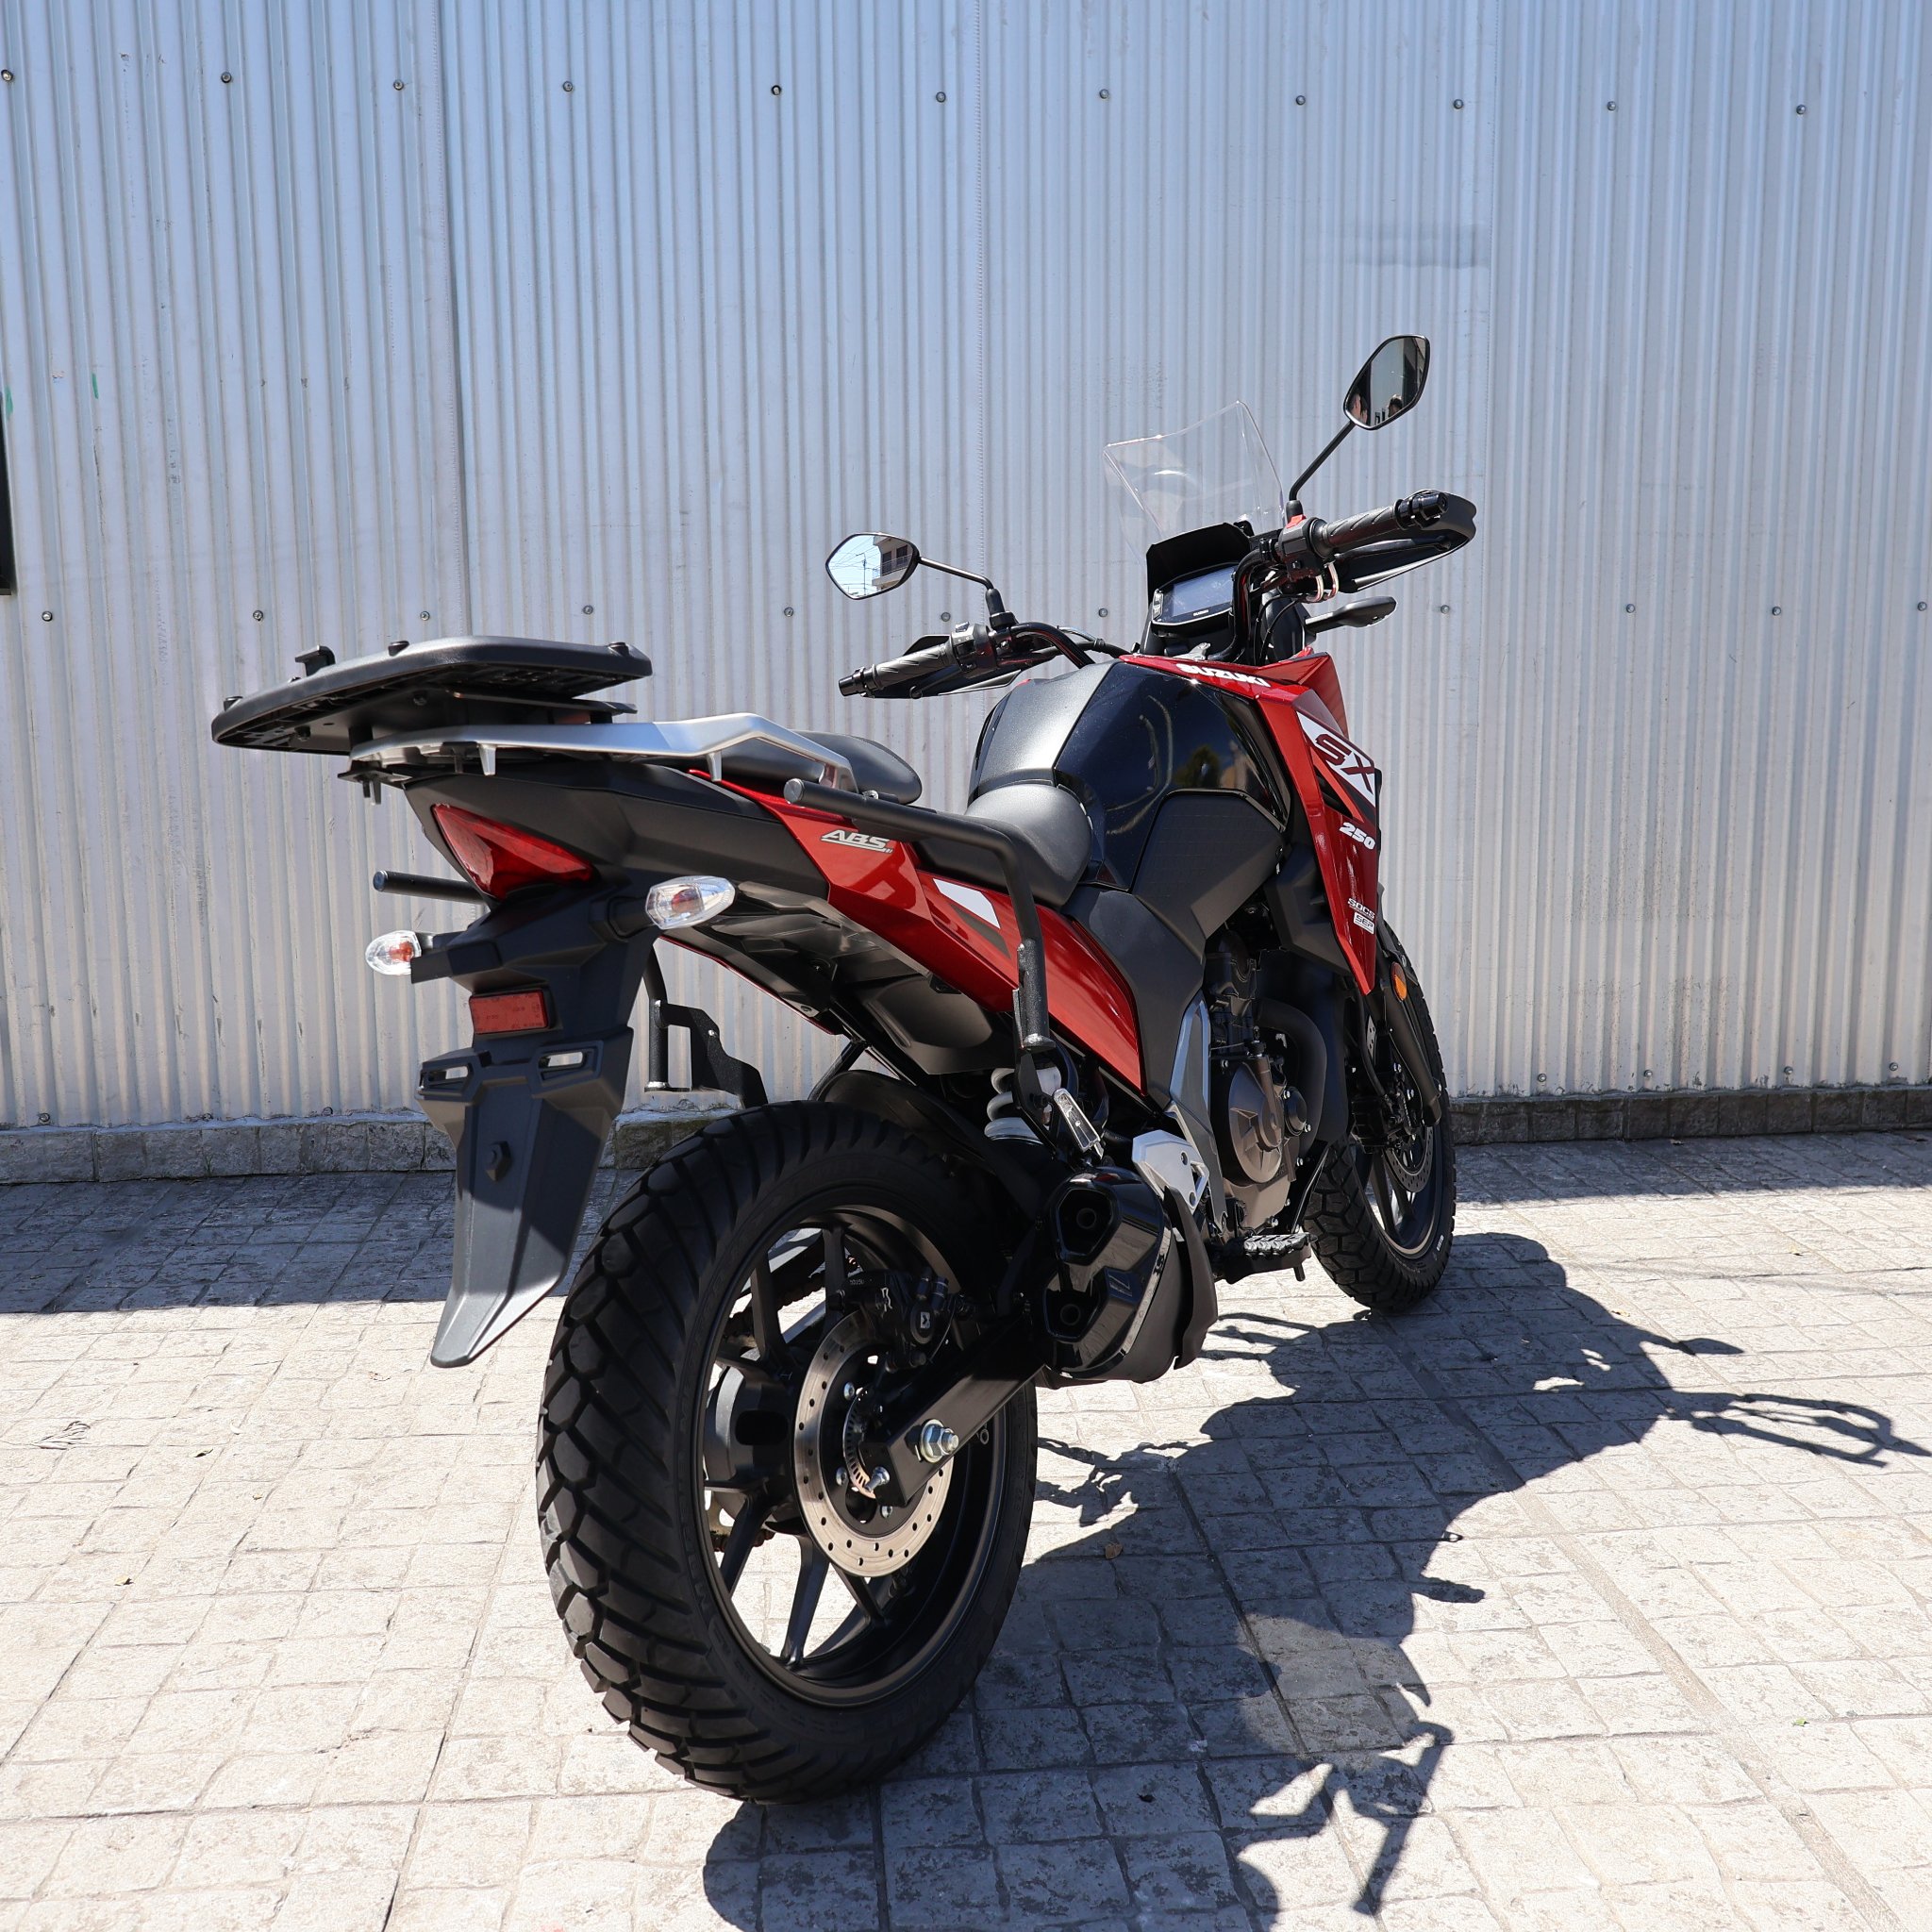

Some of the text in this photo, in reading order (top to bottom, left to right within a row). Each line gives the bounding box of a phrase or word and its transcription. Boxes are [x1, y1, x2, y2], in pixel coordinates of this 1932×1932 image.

[1176, 663, 1271, 687] SUZUKI
[1315, 734, 1375, 793] SX
[821, 829, 891, 850] ABS
[1340, 822, 1375, 850] 250
[1348, 898, 1375, 919] SOCS
[1355, 915, 1374, 927] SEP
